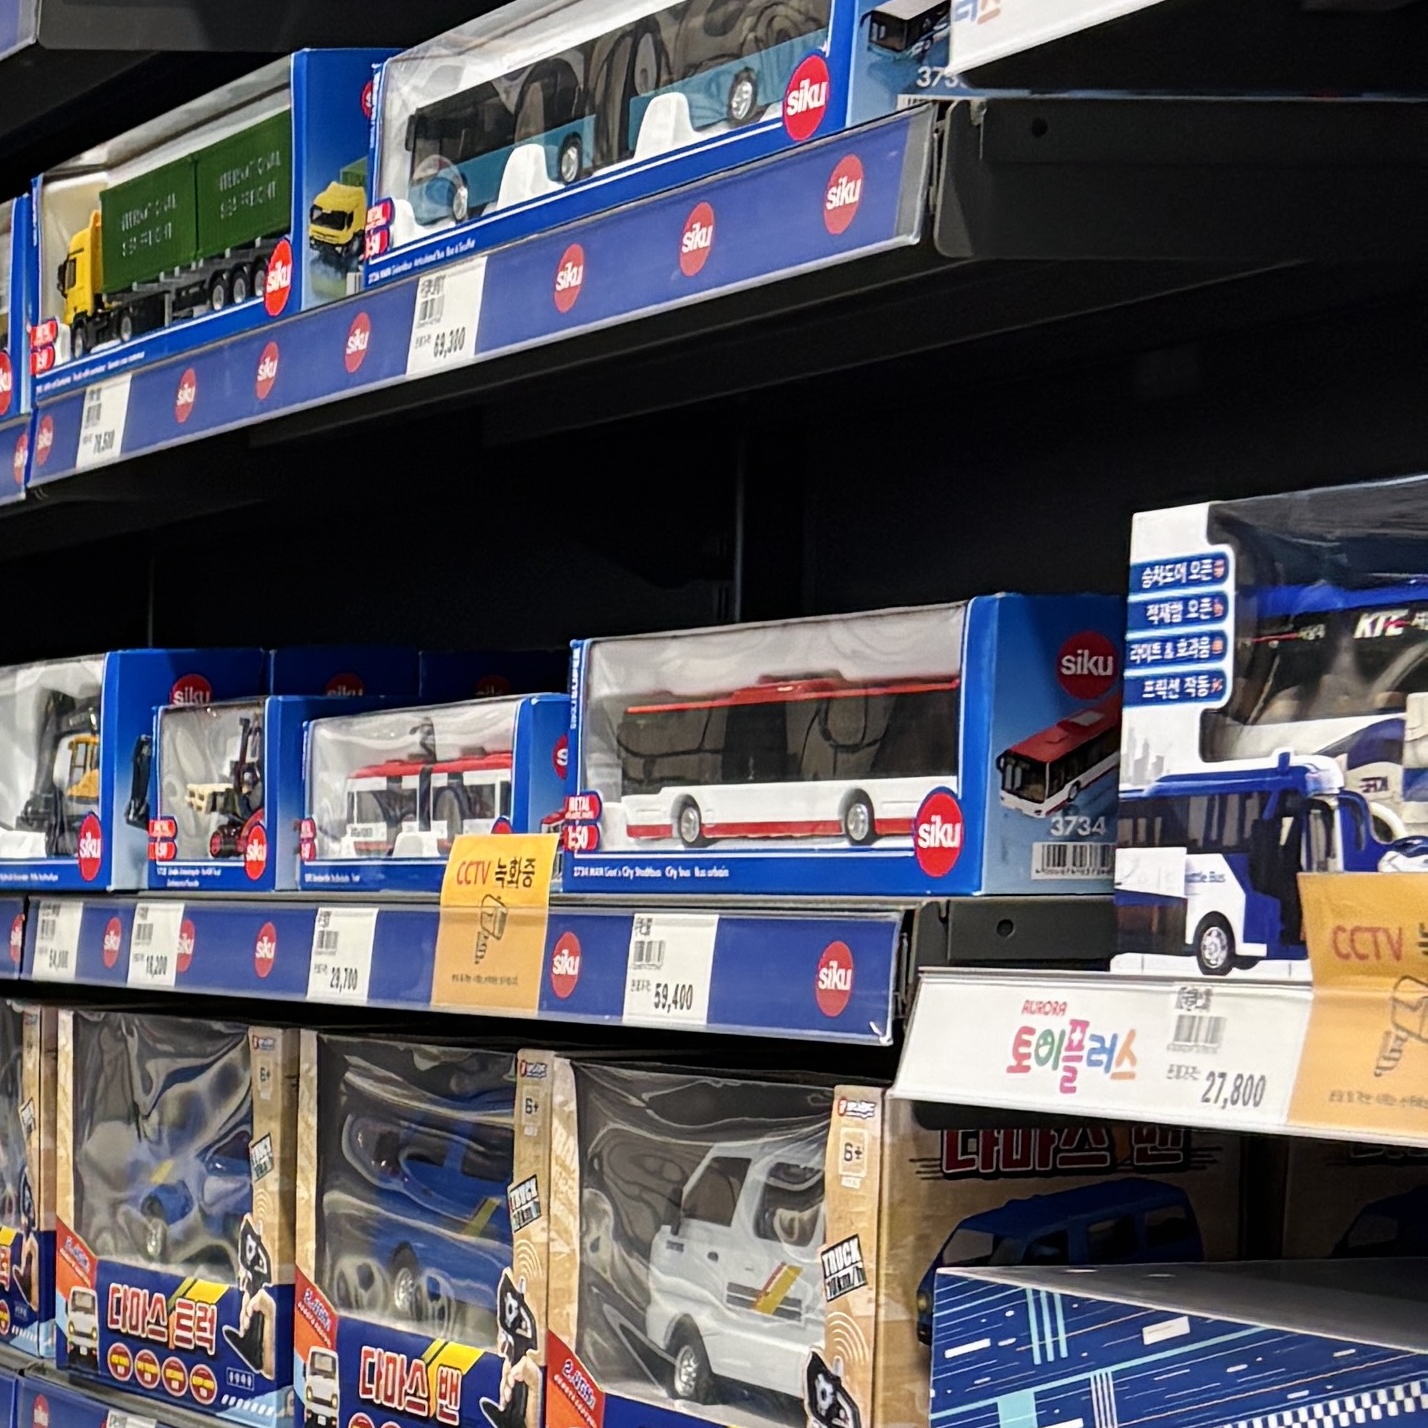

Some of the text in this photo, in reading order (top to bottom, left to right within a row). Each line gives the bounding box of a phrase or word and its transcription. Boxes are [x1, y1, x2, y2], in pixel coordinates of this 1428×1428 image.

[787, 76, 829, 116] siku
[826, 175, 861, 209] siku
[682, 223, 714, 253] siku
[556, 264, 584, 294] siku
[1061, 654, 1114, 678] siku
[918, 817, 961, 852] siku
[1051, 816, 1107, 837] 3734
[456, 860, 492, 885] CCTV
[1331, 925, 1403, 963] CCTV
[553, 954, 579, 977] siku
[818, 966, 852, 992] siku
[1006, 1019, 1137, 1094] 토이플러스
[1201, 1071, 1266, 1109] 27,800
[822, 1237, 861, 1275] TRUCK
[108, 1282, 167, 1342] 다마스
[359, 1345, 429, 1416] 다마스
